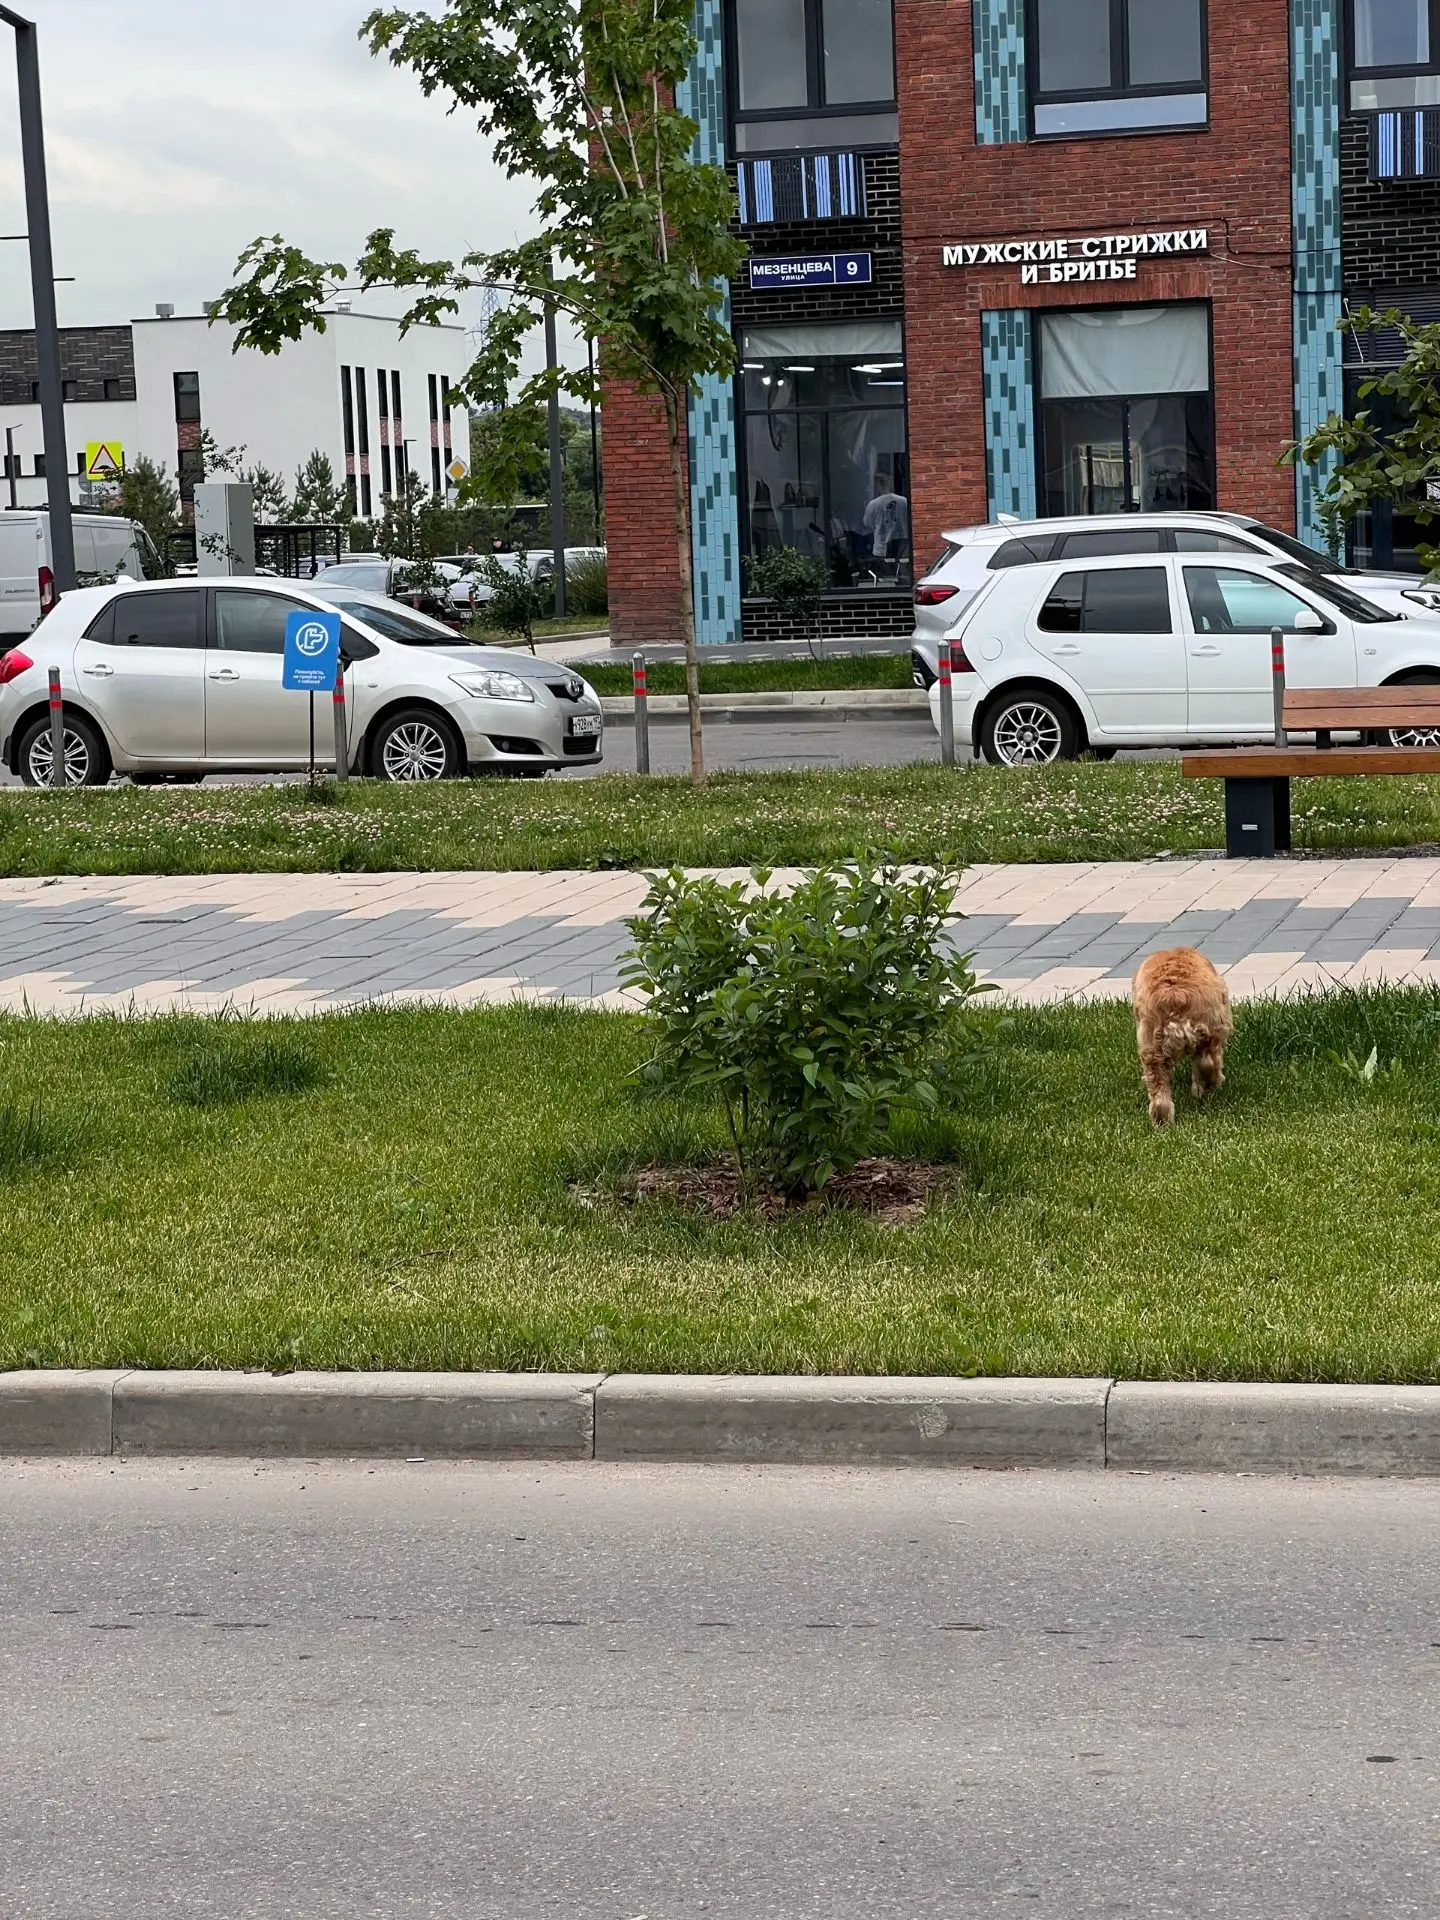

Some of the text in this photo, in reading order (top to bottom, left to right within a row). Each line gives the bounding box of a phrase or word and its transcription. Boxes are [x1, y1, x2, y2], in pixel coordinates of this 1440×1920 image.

[943, 229, 1207, 265] МУЖСКИЕ СТРИЖКИ
[753, 261, 858, 276] МЕЗЕНЦЕВА 9
[1021, 259, 1136, 284] И БРИТЬЕ
